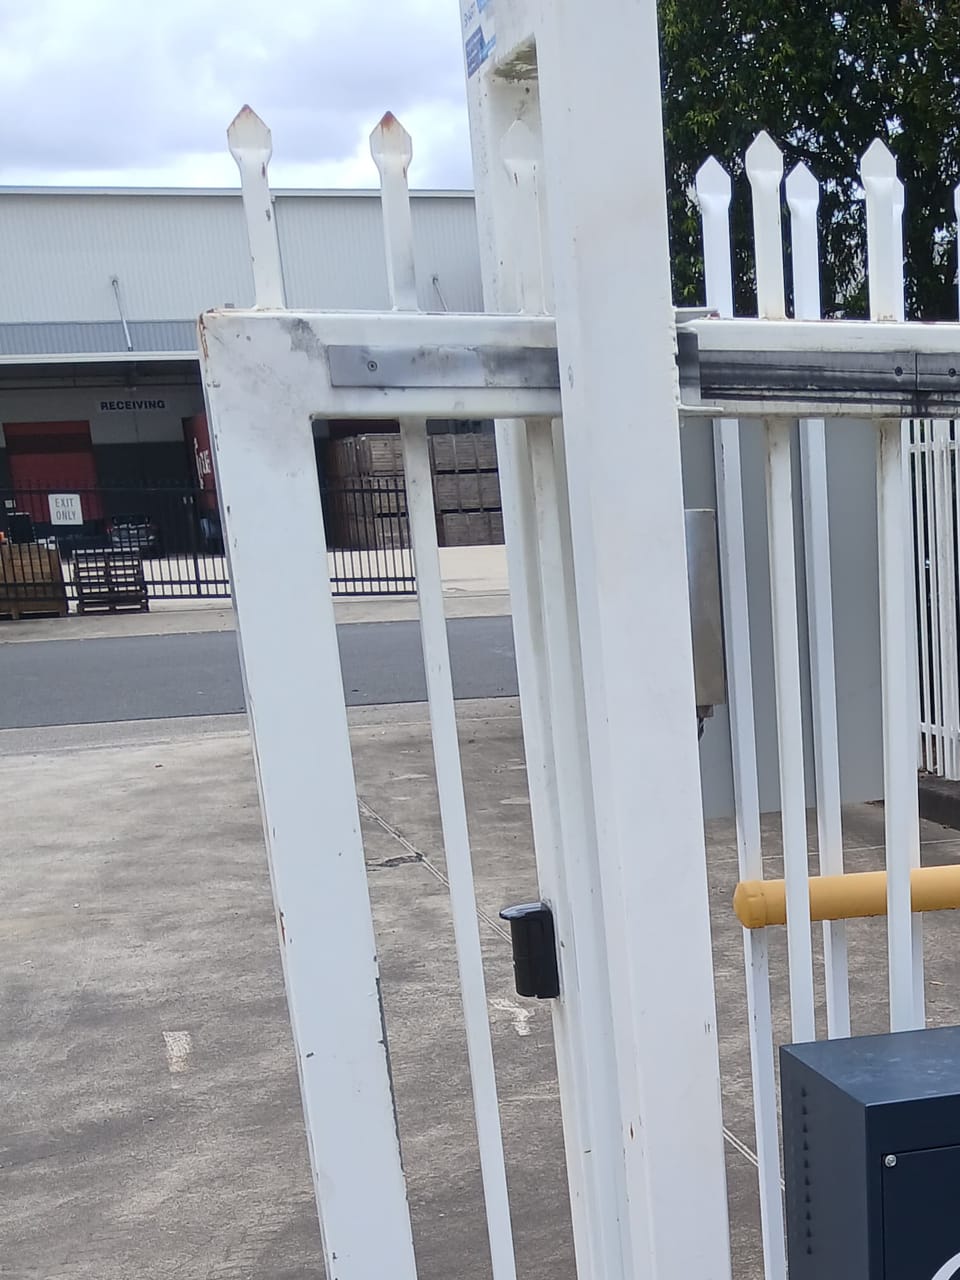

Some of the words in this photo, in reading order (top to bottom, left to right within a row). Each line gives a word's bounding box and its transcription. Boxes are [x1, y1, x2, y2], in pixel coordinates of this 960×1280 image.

[100, 400, 166, 411] RECEIVING
[55, 497, 74, 508] EXIT
[56, 510, 77, 521] ONLY
